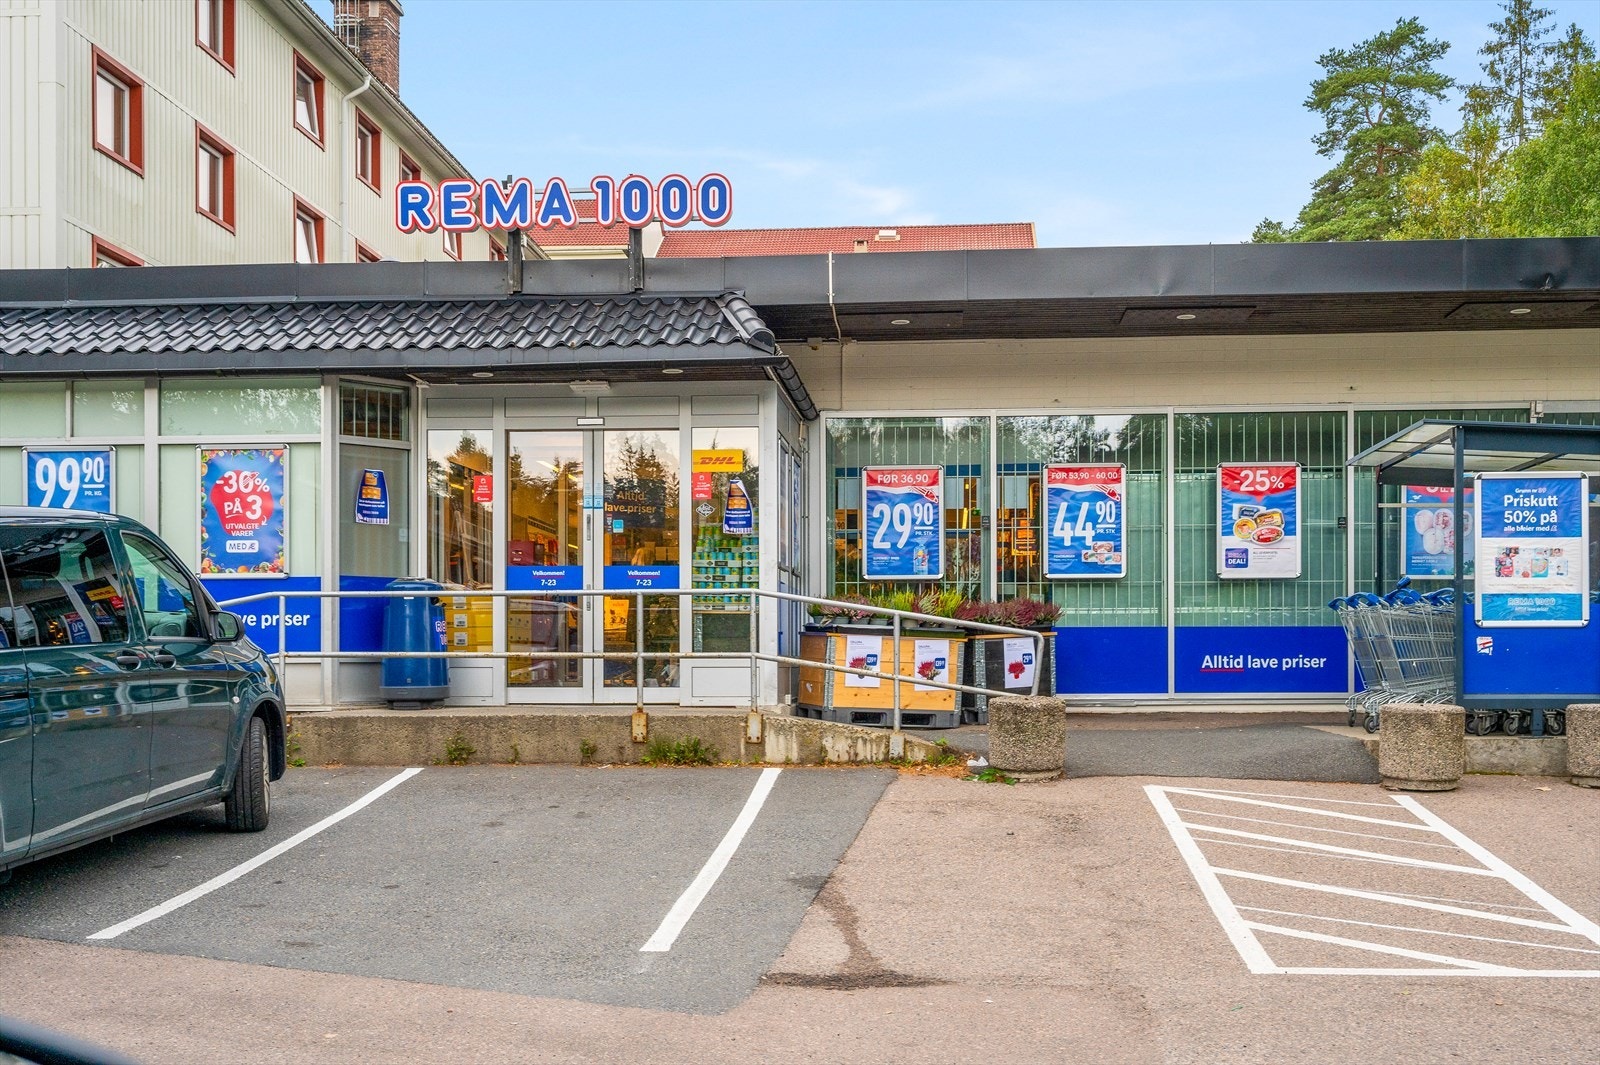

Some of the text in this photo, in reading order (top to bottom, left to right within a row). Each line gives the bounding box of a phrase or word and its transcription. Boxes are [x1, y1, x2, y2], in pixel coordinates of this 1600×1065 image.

[395, 173, 734, 233] REMA 1000
[700, 456, 736, 465] DHL
[35, 457, 104, 509] 99 90
[216, 470, 270, 493] -30%
[877, 474, 929, 484] FØR 36,90
[1069, 472, 1090, 480] 53,90
[1096, 472, 1118, 480] 60,00
[1234, 469, 1285, 492] -25%
[617, 490, 645, 500] Alltid
[1503, 494, 1558, 507] Priskutt
[224, 495, 263, 520] PÅ 3
[604, 502, 657, 514] lave priser
[872, 503, 934, 549] 29 90
[1053, 501, 1116, 546] 44 90
[1503, 510, 1558, 525] 50% på
[261, 613, 311, 630] prser
[1201, 654, 1327, 671] Alltid lave priser
